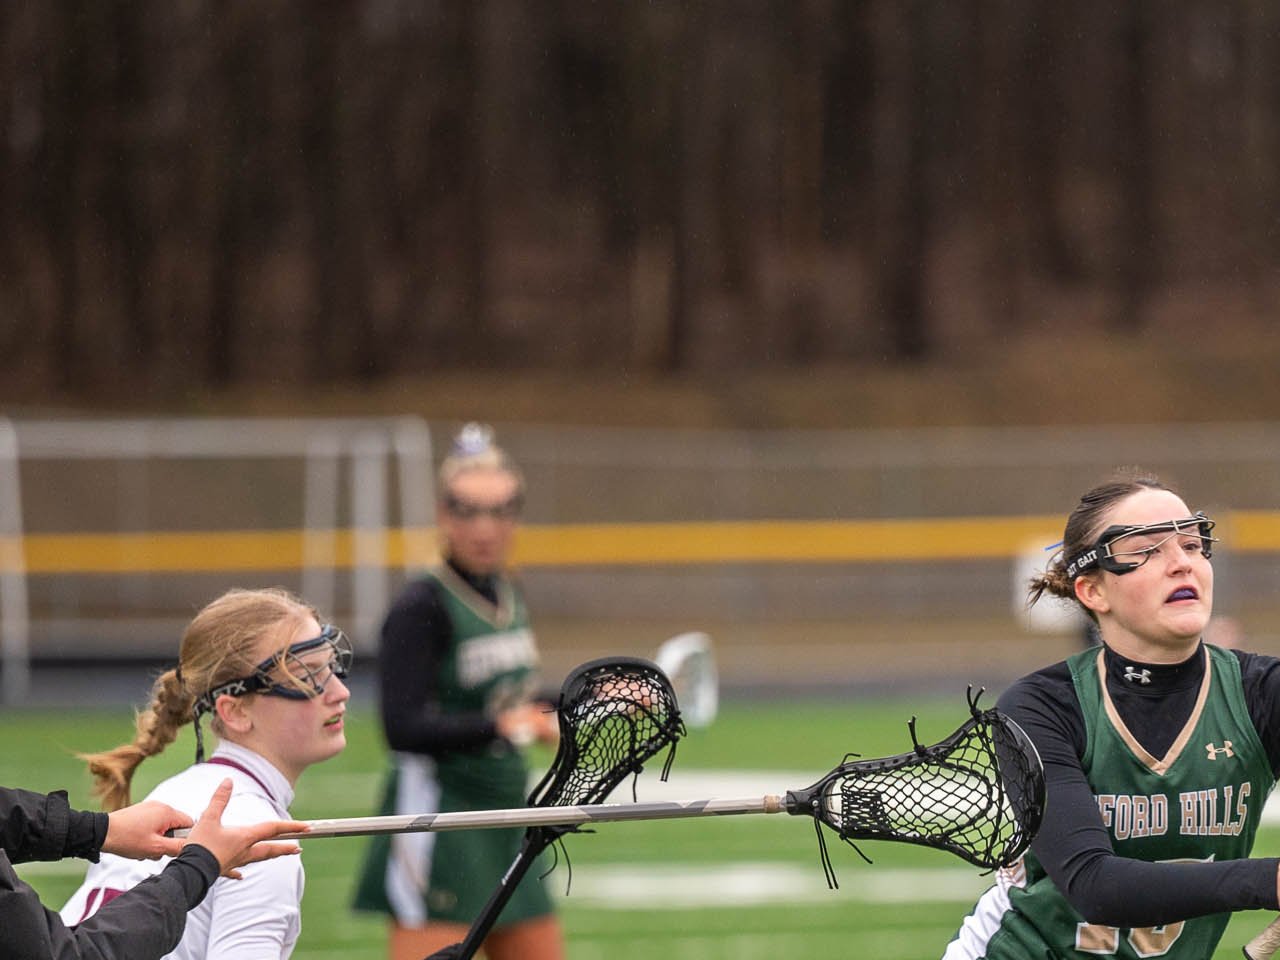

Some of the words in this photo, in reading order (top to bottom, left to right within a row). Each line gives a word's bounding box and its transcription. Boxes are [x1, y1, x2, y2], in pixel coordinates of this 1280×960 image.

[1077, 550, 1098, 569] GAIT
[1093, 794, 1169, 841] FORD
[1179, 781, 1252, 837] HILLS
